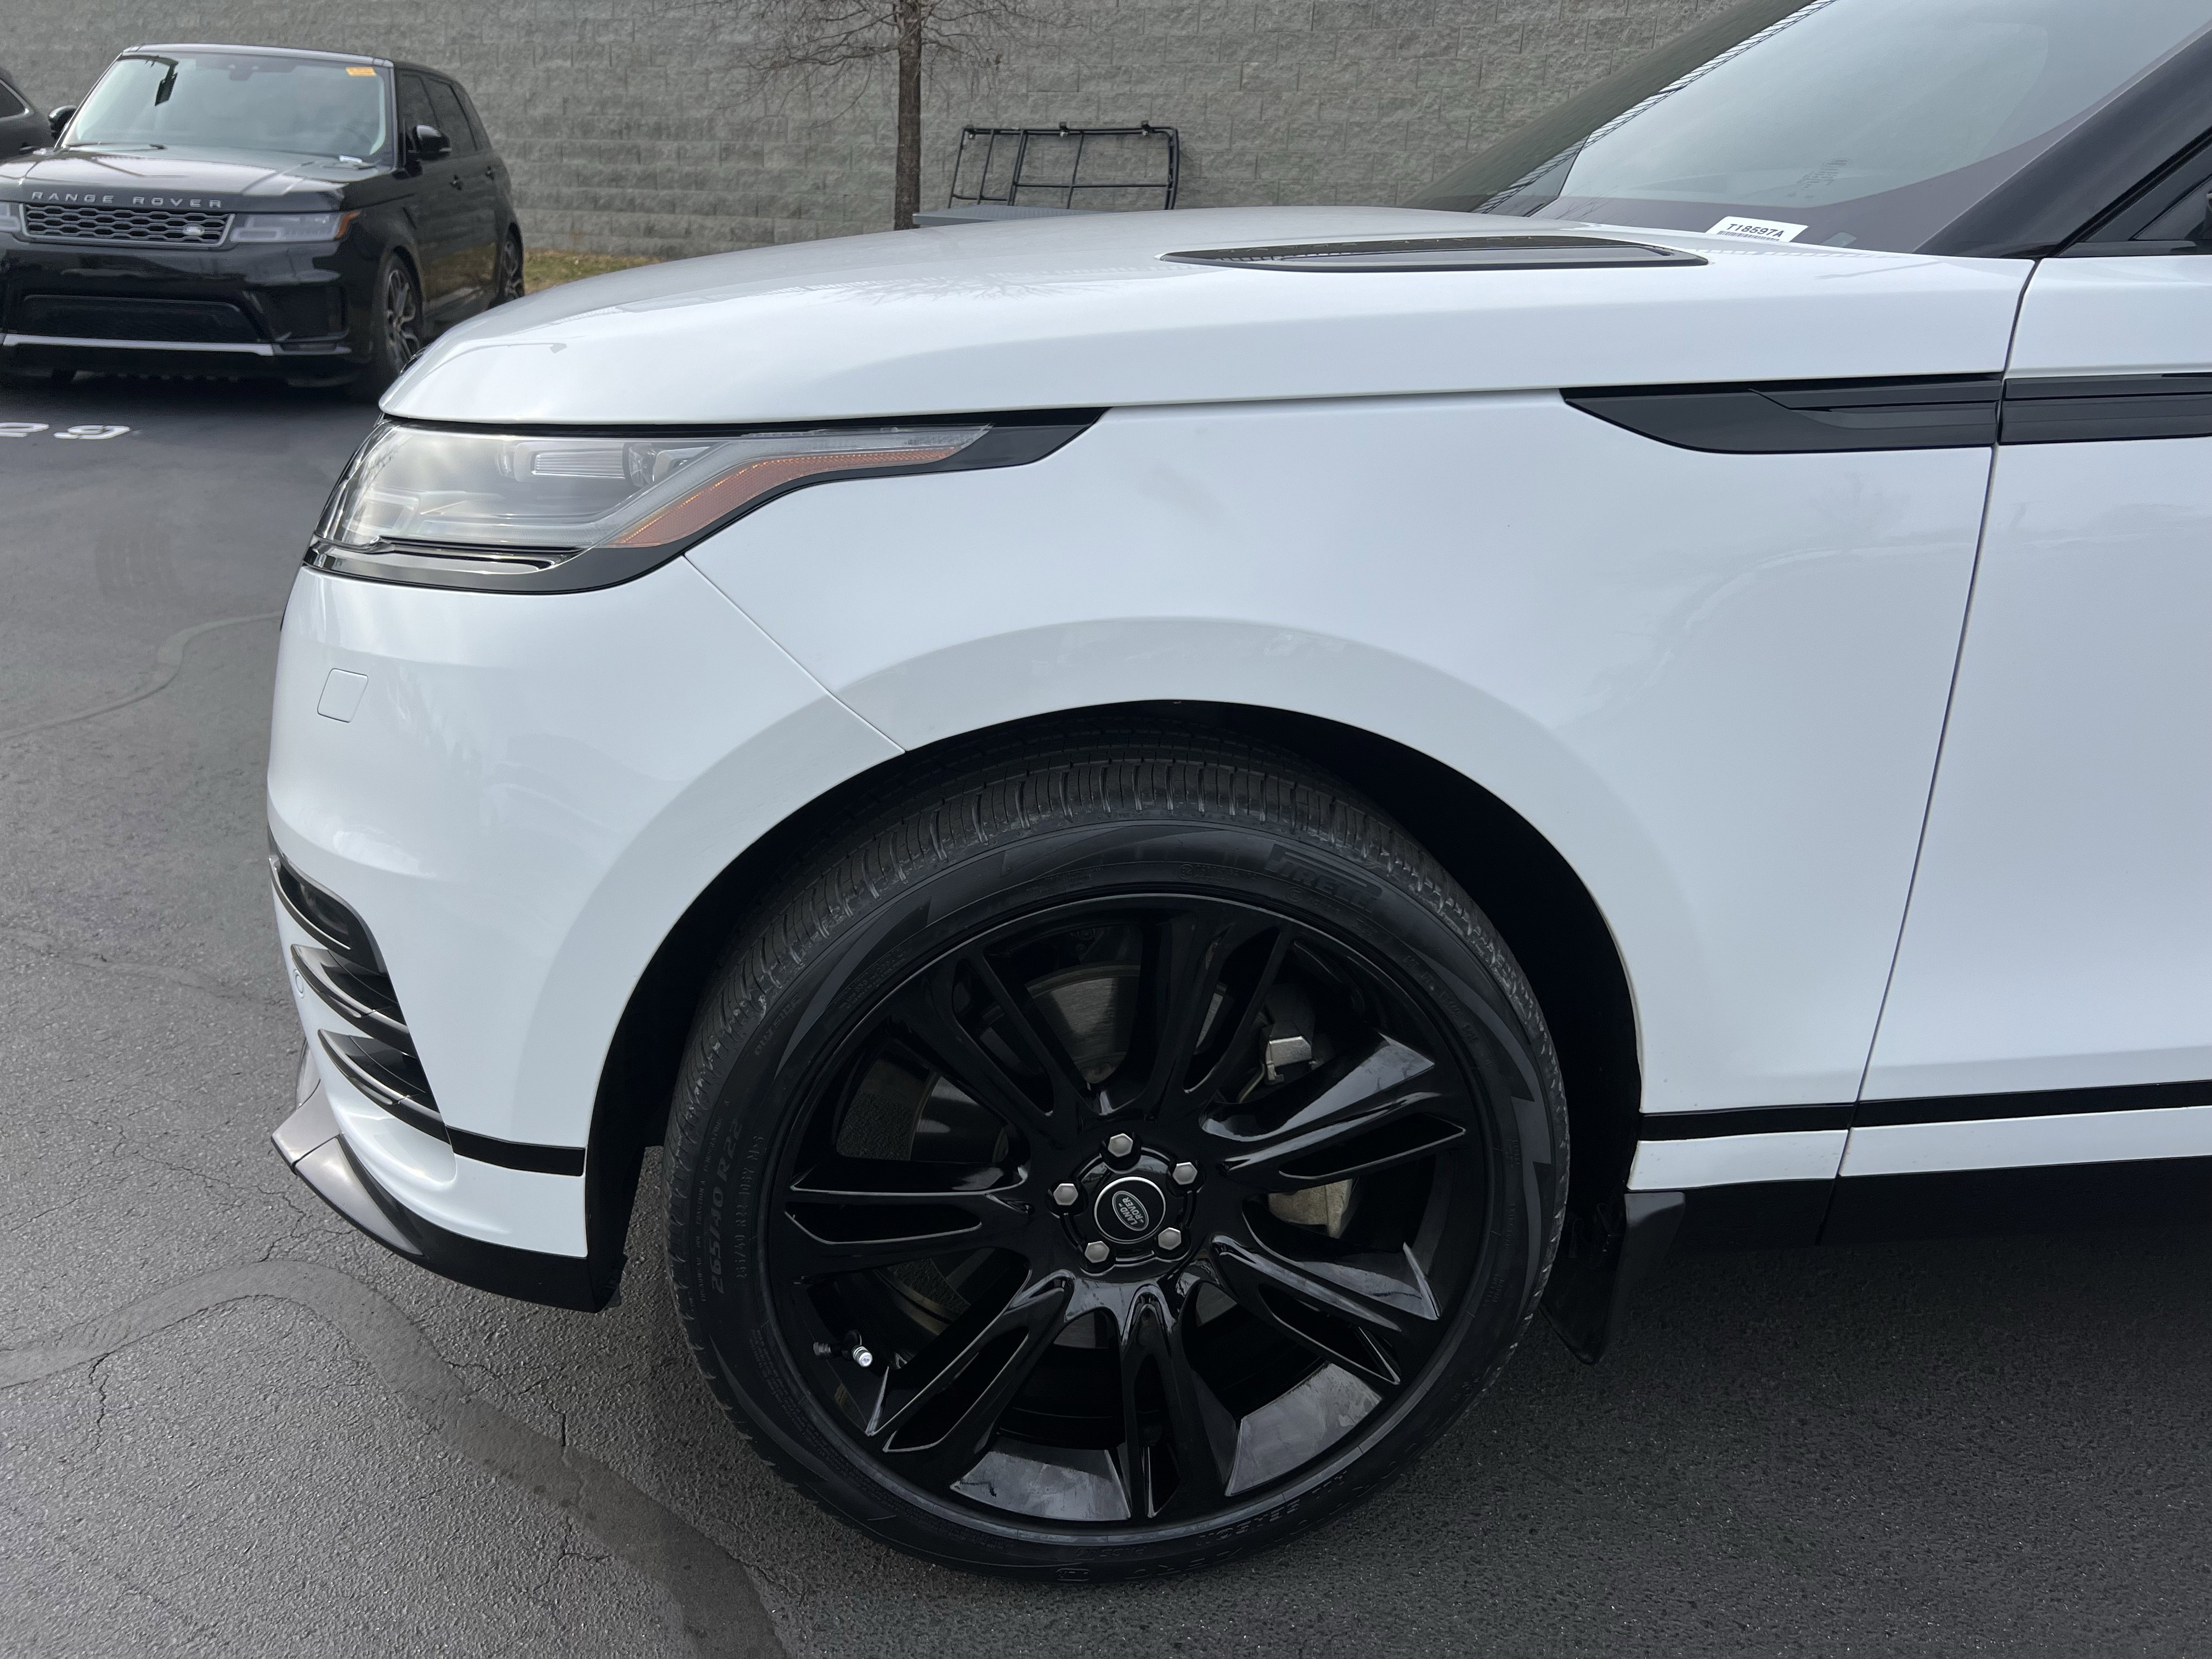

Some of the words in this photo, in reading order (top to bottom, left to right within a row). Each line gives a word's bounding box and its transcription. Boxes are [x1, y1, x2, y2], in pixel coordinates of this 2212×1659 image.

[32, 191, 114, 204] RANGE
[132, 196, 223, 208] ROVER
[1727, 224, 1784, 238] T18597A
[716, 1117, 743, 1182] R22
[1119, 1205, 1138, 1225] LAND
[1122, 1197, 1144, 1221] ROVER
[709, 1187, 725, 1295] 265/40
